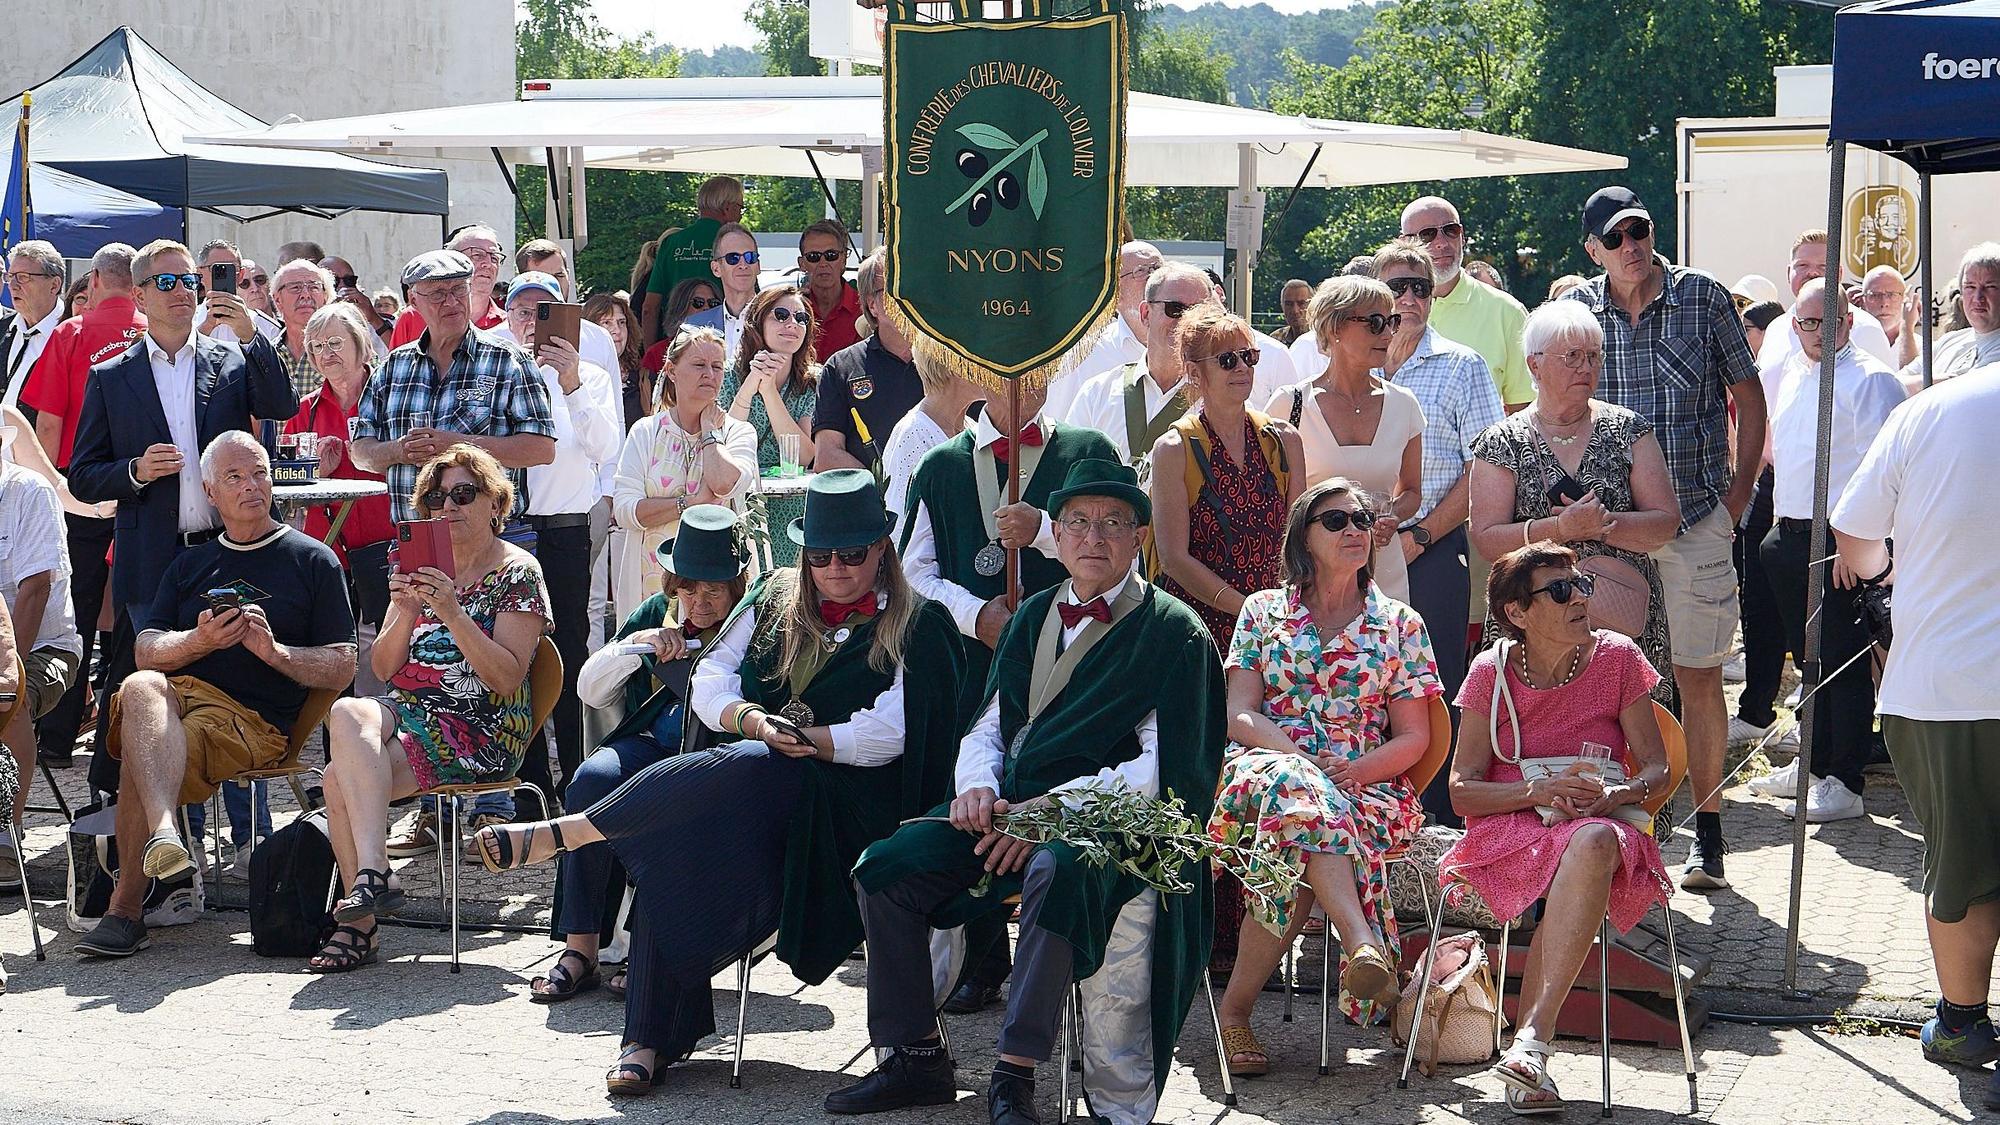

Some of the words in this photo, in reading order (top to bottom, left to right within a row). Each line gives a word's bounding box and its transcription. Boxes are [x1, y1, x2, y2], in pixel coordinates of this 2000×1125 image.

[1922, 52, 2000, 80] foer
[949, 79, 972, 103] DES
[969, 61, 1063, 101] CHEVALIERS
[1053, 93, 1071, 113] DE
[1064, 104, 1096, 179] L'OLIVIER
[947, 247, 1064, 273] NYONS
[981, 299, 1032, 316] 1964
[122, 329, 137, 339] KG
